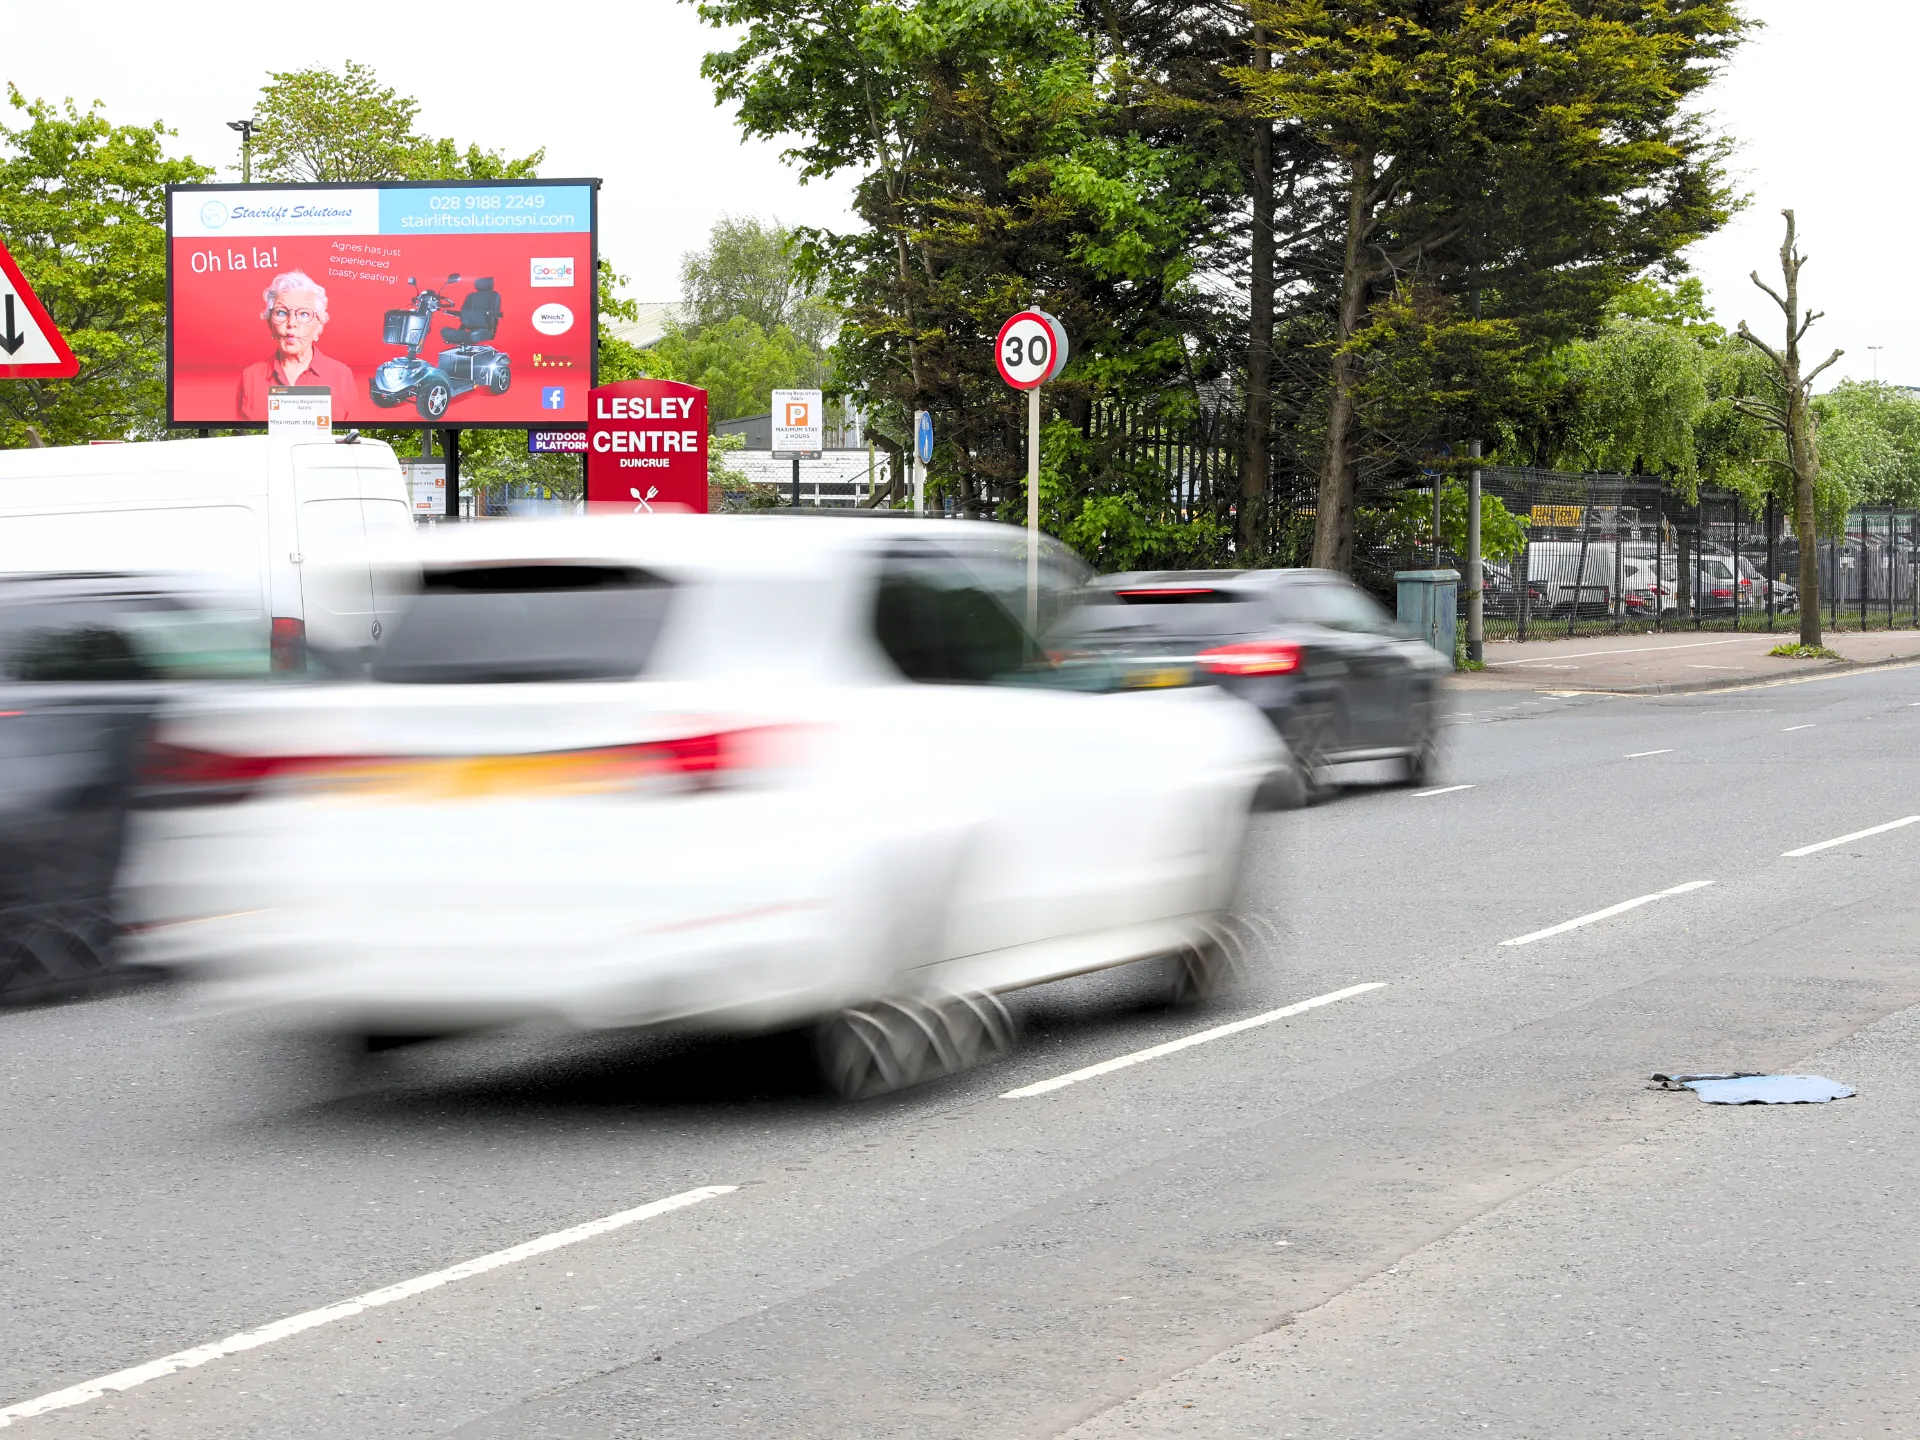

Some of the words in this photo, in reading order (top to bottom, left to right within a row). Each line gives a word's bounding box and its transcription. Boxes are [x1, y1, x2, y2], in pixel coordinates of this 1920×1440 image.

[429, 196, 461, 210] 028
[465, 195, 501, 210] 9188
[504, 194, 545, 209] 2249
[230, 206, 289, 221] Stairlift
[290, 205, 353, 218] Solutions
[401, 212, 575, 228] stairliftsolutionsni.com
[331, 240, 363, 253] Agnes
[364, 243, 382, 255] has
[382, 246, 401, 257] just
[191, 250, 222, 273] Oh
[227, 248, 247, 271] la
[252, 246, 278, 269] la!
[329, 254, 390, 269] experienced
[328, 267, 358, 280] toasty
[359, 271, 398, 285] seating!
[533, 264, 572, 278] Google
[1005, 335, 1048, 367] 30
[596, 397, 695, 419] LESLEY
[320, 417, 326, 425] 2
[535, 432, 586, 441] OUTDOOR
[592, 430, 698, 453] CENTRE
[619, 458, 670, 468] DUNCRUE
